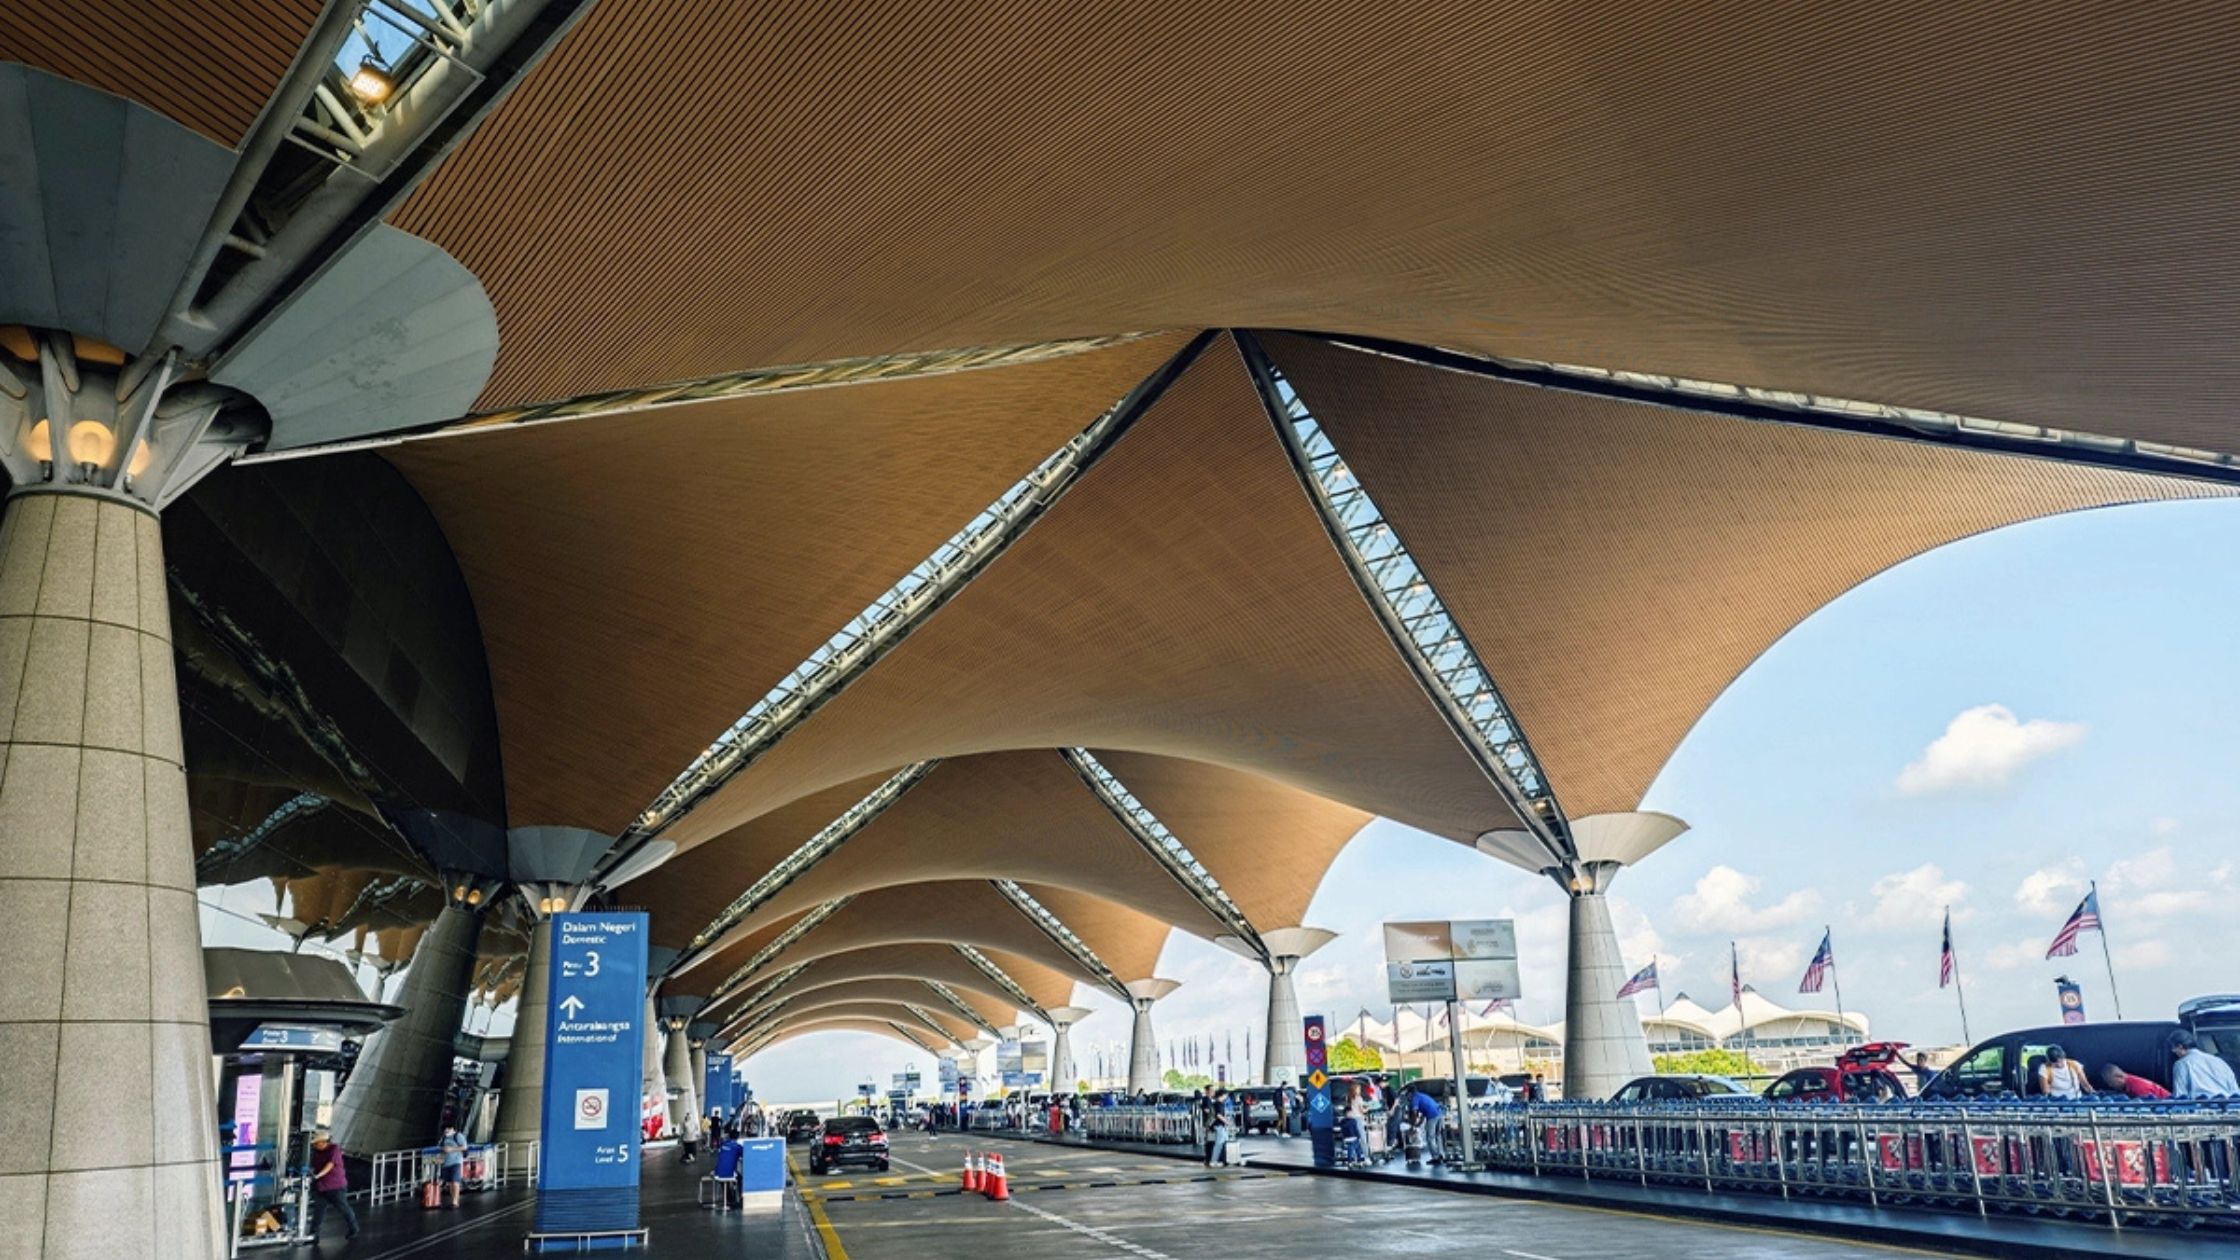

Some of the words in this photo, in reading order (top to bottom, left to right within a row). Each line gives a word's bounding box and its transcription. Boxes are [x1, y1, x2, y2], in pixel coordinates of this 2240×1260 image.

[563, 922, 596, 932] Dalam
[600, 922, 635, 934] Negeri
[563, 934, 606, 944] Domestic
[584, 951, 600, 977] 3
[280, 1030, 288, 1043] 3
[558, 1034, 617, 1043] International
[618, 1143, 629, 1163] 5
